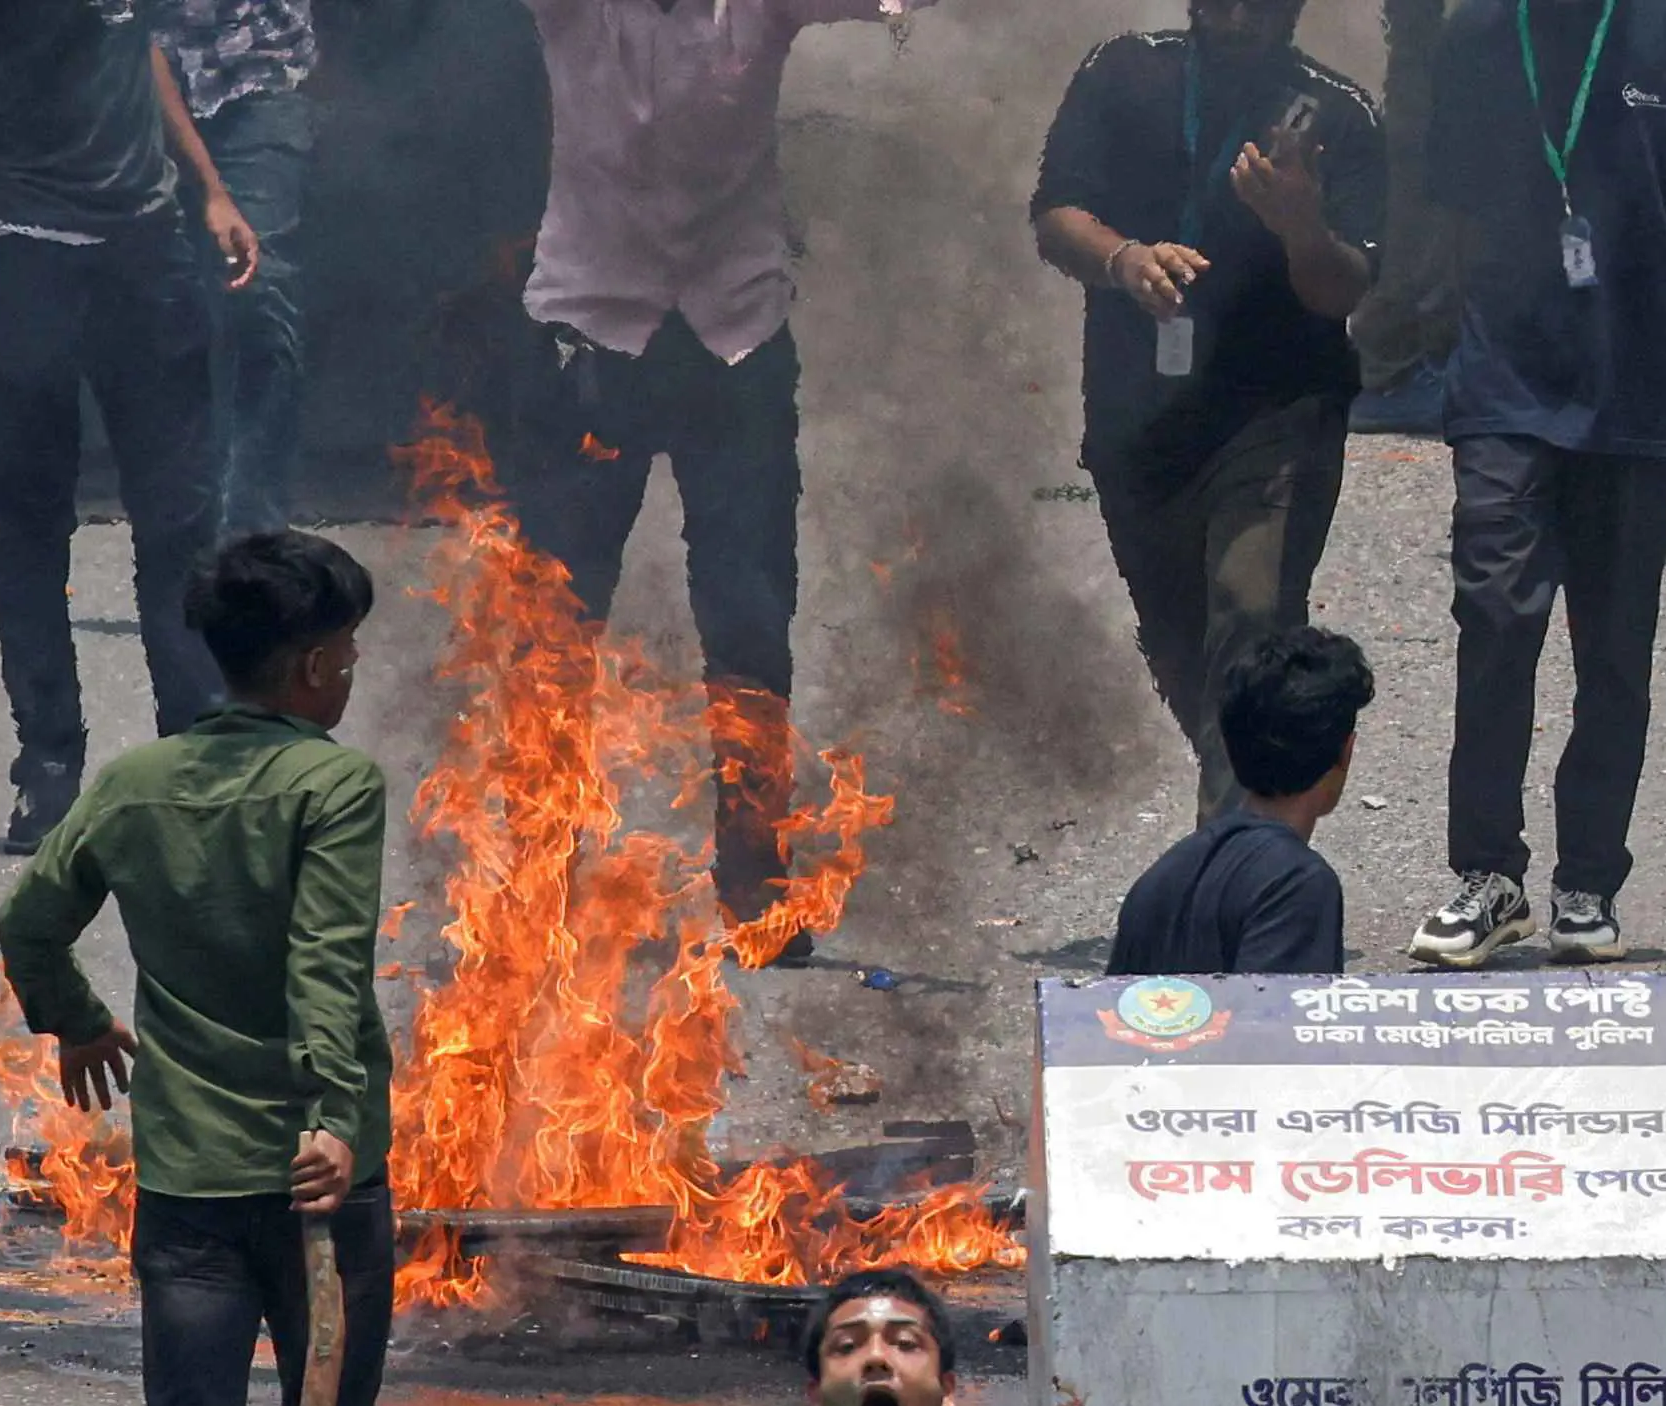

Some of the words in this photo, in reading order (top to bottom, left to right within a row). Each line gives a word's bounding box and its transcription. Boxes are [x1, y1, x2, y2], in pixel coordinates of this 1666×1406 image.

[1290, 977, 1420, 1021] পুলিশ
[1432, 987, 1531, 1013] চেক
[1543, 979, 1653, 1018] পোস্ট
[1293, 1024, 1365, 1045] ঢাকা
[1374, 1019, 1555, 1049] মেট্রোপলিটন
[1564, 1019, 1654, 1051] পুলিশ
[1126, 1108, 1257, 1138] ওমেরা
[1276, 1100, 1461, 1136] এলপিজি
[1480, 1102, 1665, 1139] সিলিন্ডার
[1125, 1160, 1255, 1198] হোম
[1277, 1148, 1567, 1202] ডেলিভারি
[1276, 1216, 1363, 1240] কল
